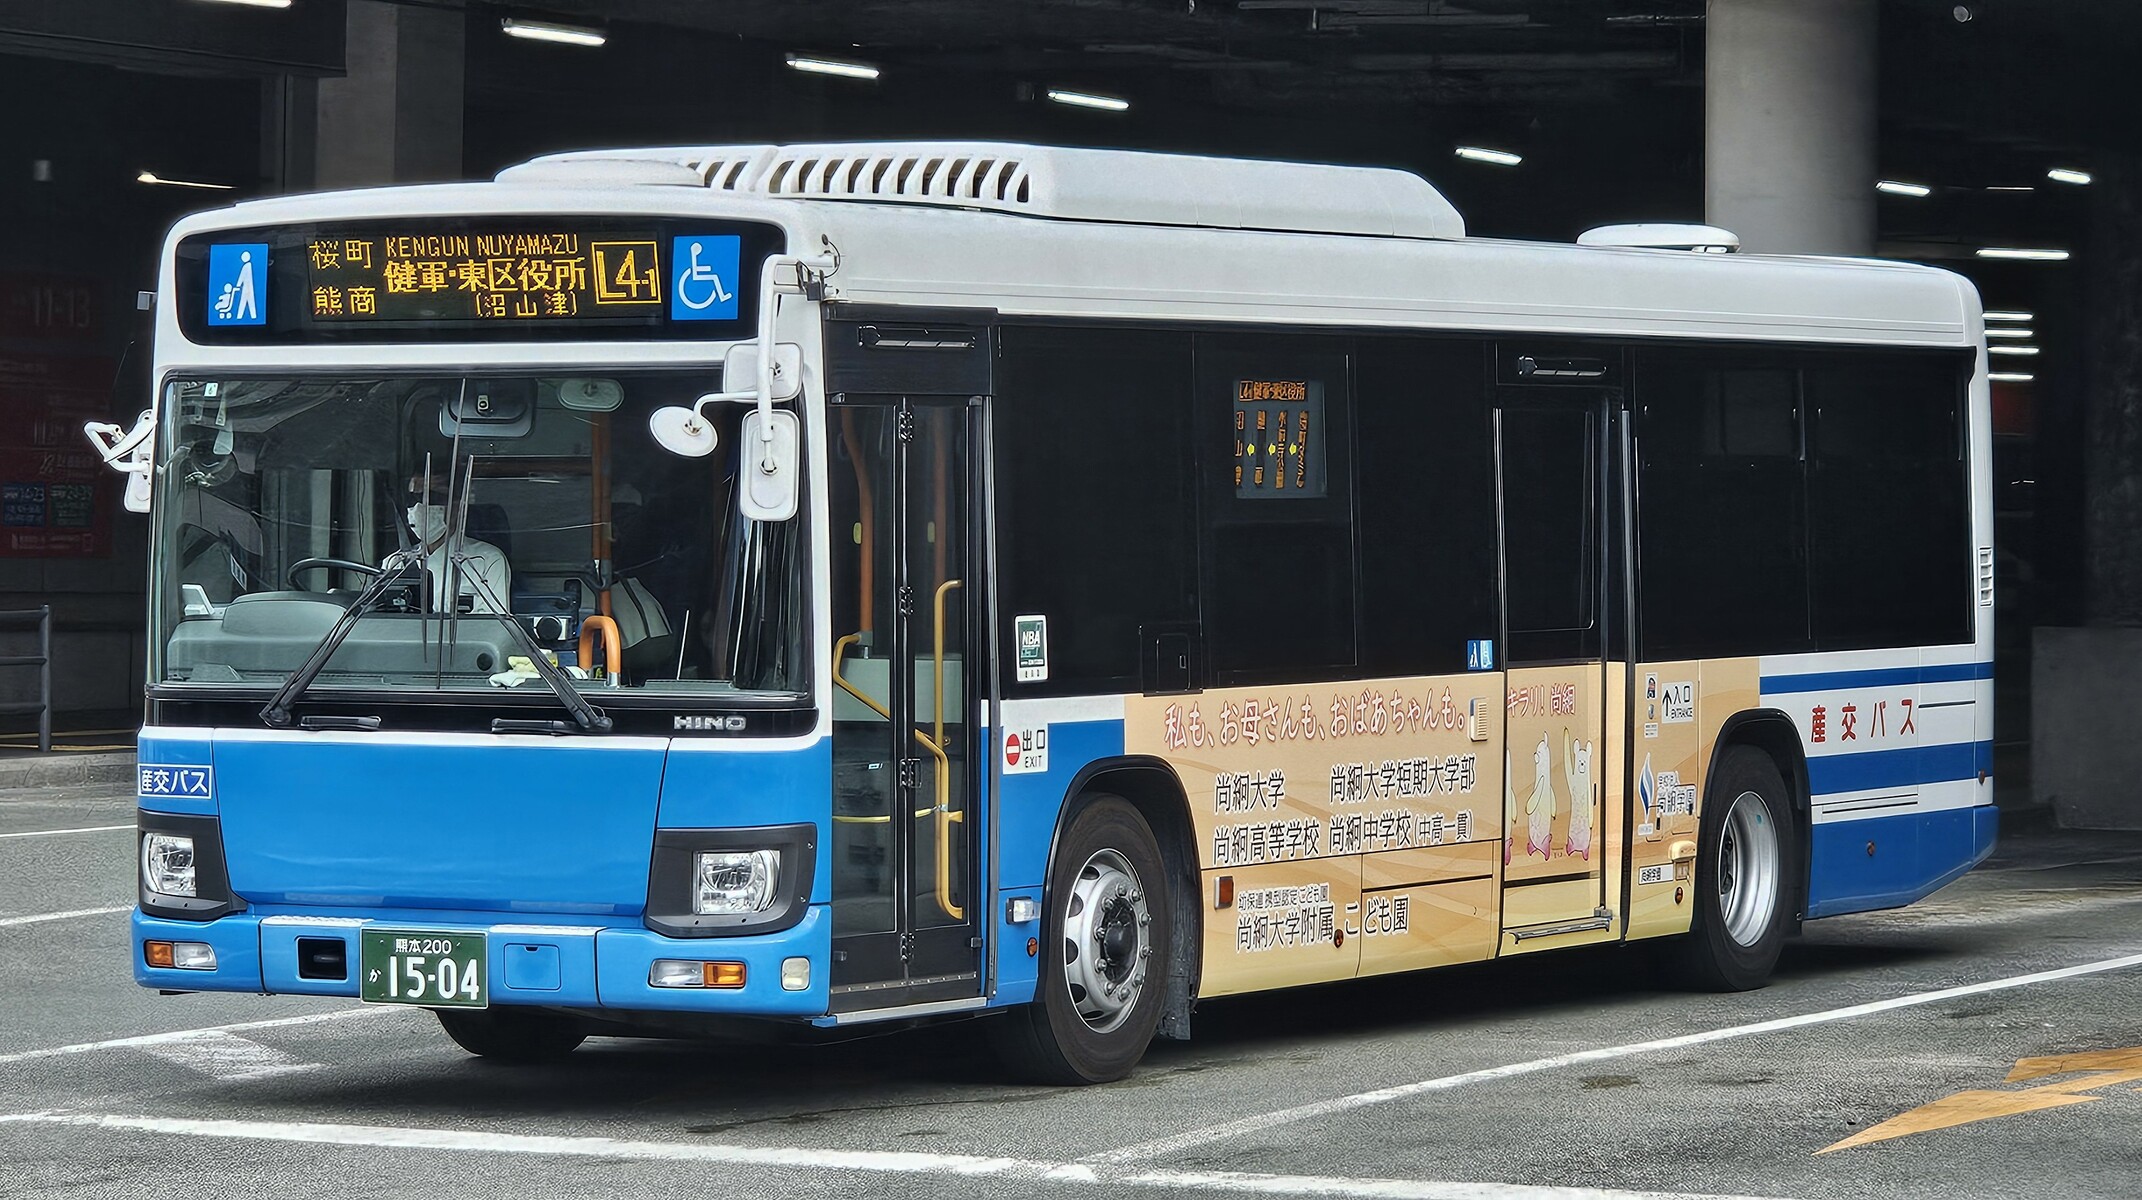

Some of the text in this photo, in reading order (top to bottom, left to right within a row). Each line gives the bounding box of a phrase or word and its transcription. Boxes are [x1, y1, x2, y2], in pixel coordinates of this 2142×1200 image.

[309, 239, 373, 270] 桜町
[385, 233, 578, 257] KENGUN NUYAMAZU
[314, 286, 376, 315] 熊商
[1022, 630, 1041, 647] NBA
[1673, 685, 1691, 705] 入口
[674, 715, 747, 731] HINO
[1811, 698, 1915, 742] 産交バス
[1023, 729, 1046, 751] 出口
[1025, 755, 1043, 768] EXIT
[142, 769, 208, 794] 産交バス
[368, 955, 480, 1001] か 15-04
